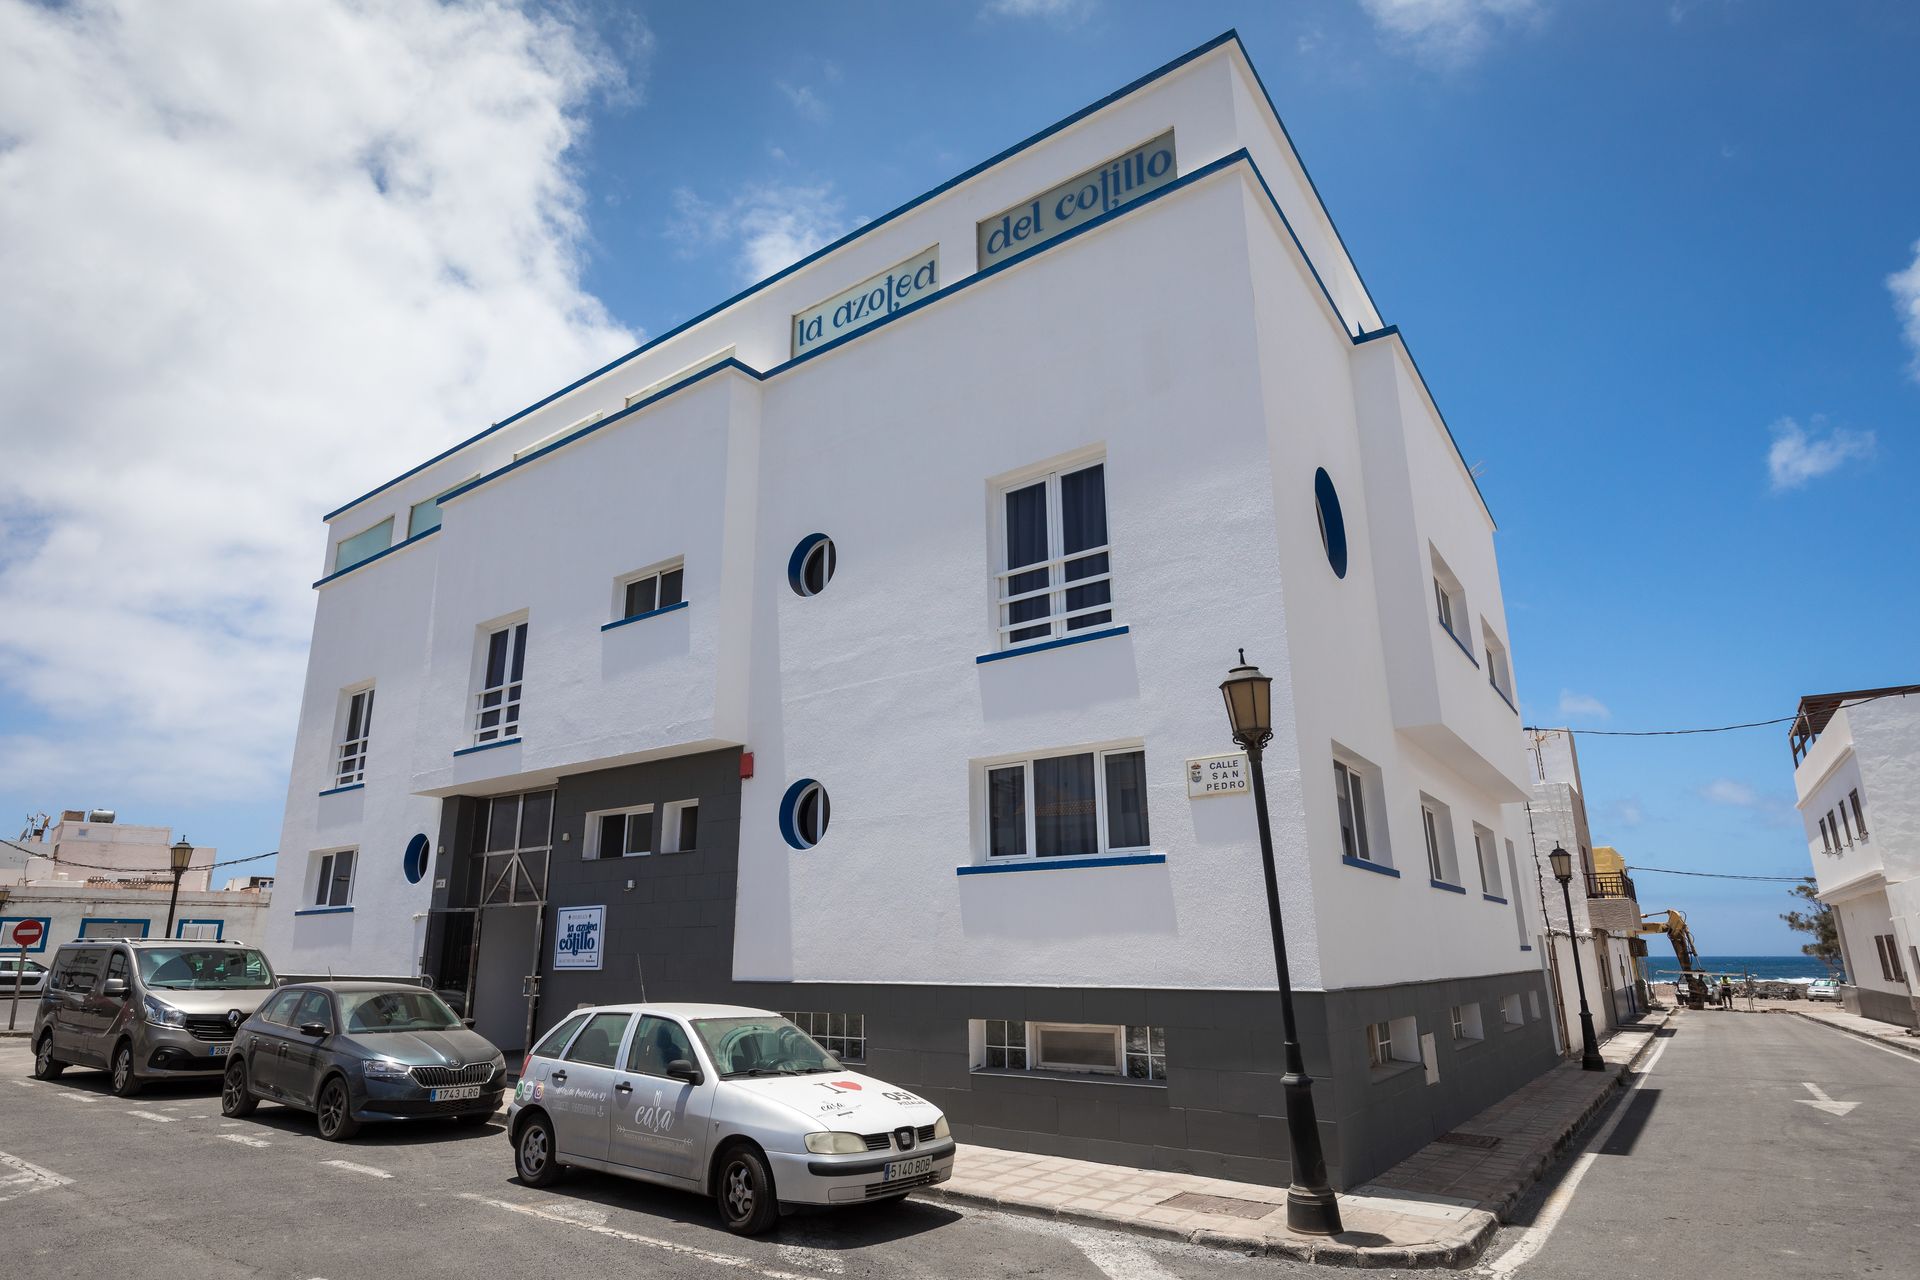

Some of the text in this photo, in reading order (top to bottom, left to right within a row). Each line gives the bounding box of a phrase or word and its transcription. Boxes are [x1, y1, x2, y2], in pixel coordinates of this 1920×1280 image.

[987, 149, 1172, 255] del cotillo
[799, 260, 937, 347] la azotea
[1209, 760, 1239, 770] CALLE
[1211, 770, 1239, 780] SAN
[1206, 780, 1245, 791] PEDRO
[567, 921, 597, 934] la azotea
[559, 931, 595, 956] cotillo
[215, 1047, 230, 1055] 283
[438, 1087, 479, 1100] 1743 LRG
[635, 1105, 675, 1133] casa
[891, 1161, 914, 1178] 5140
